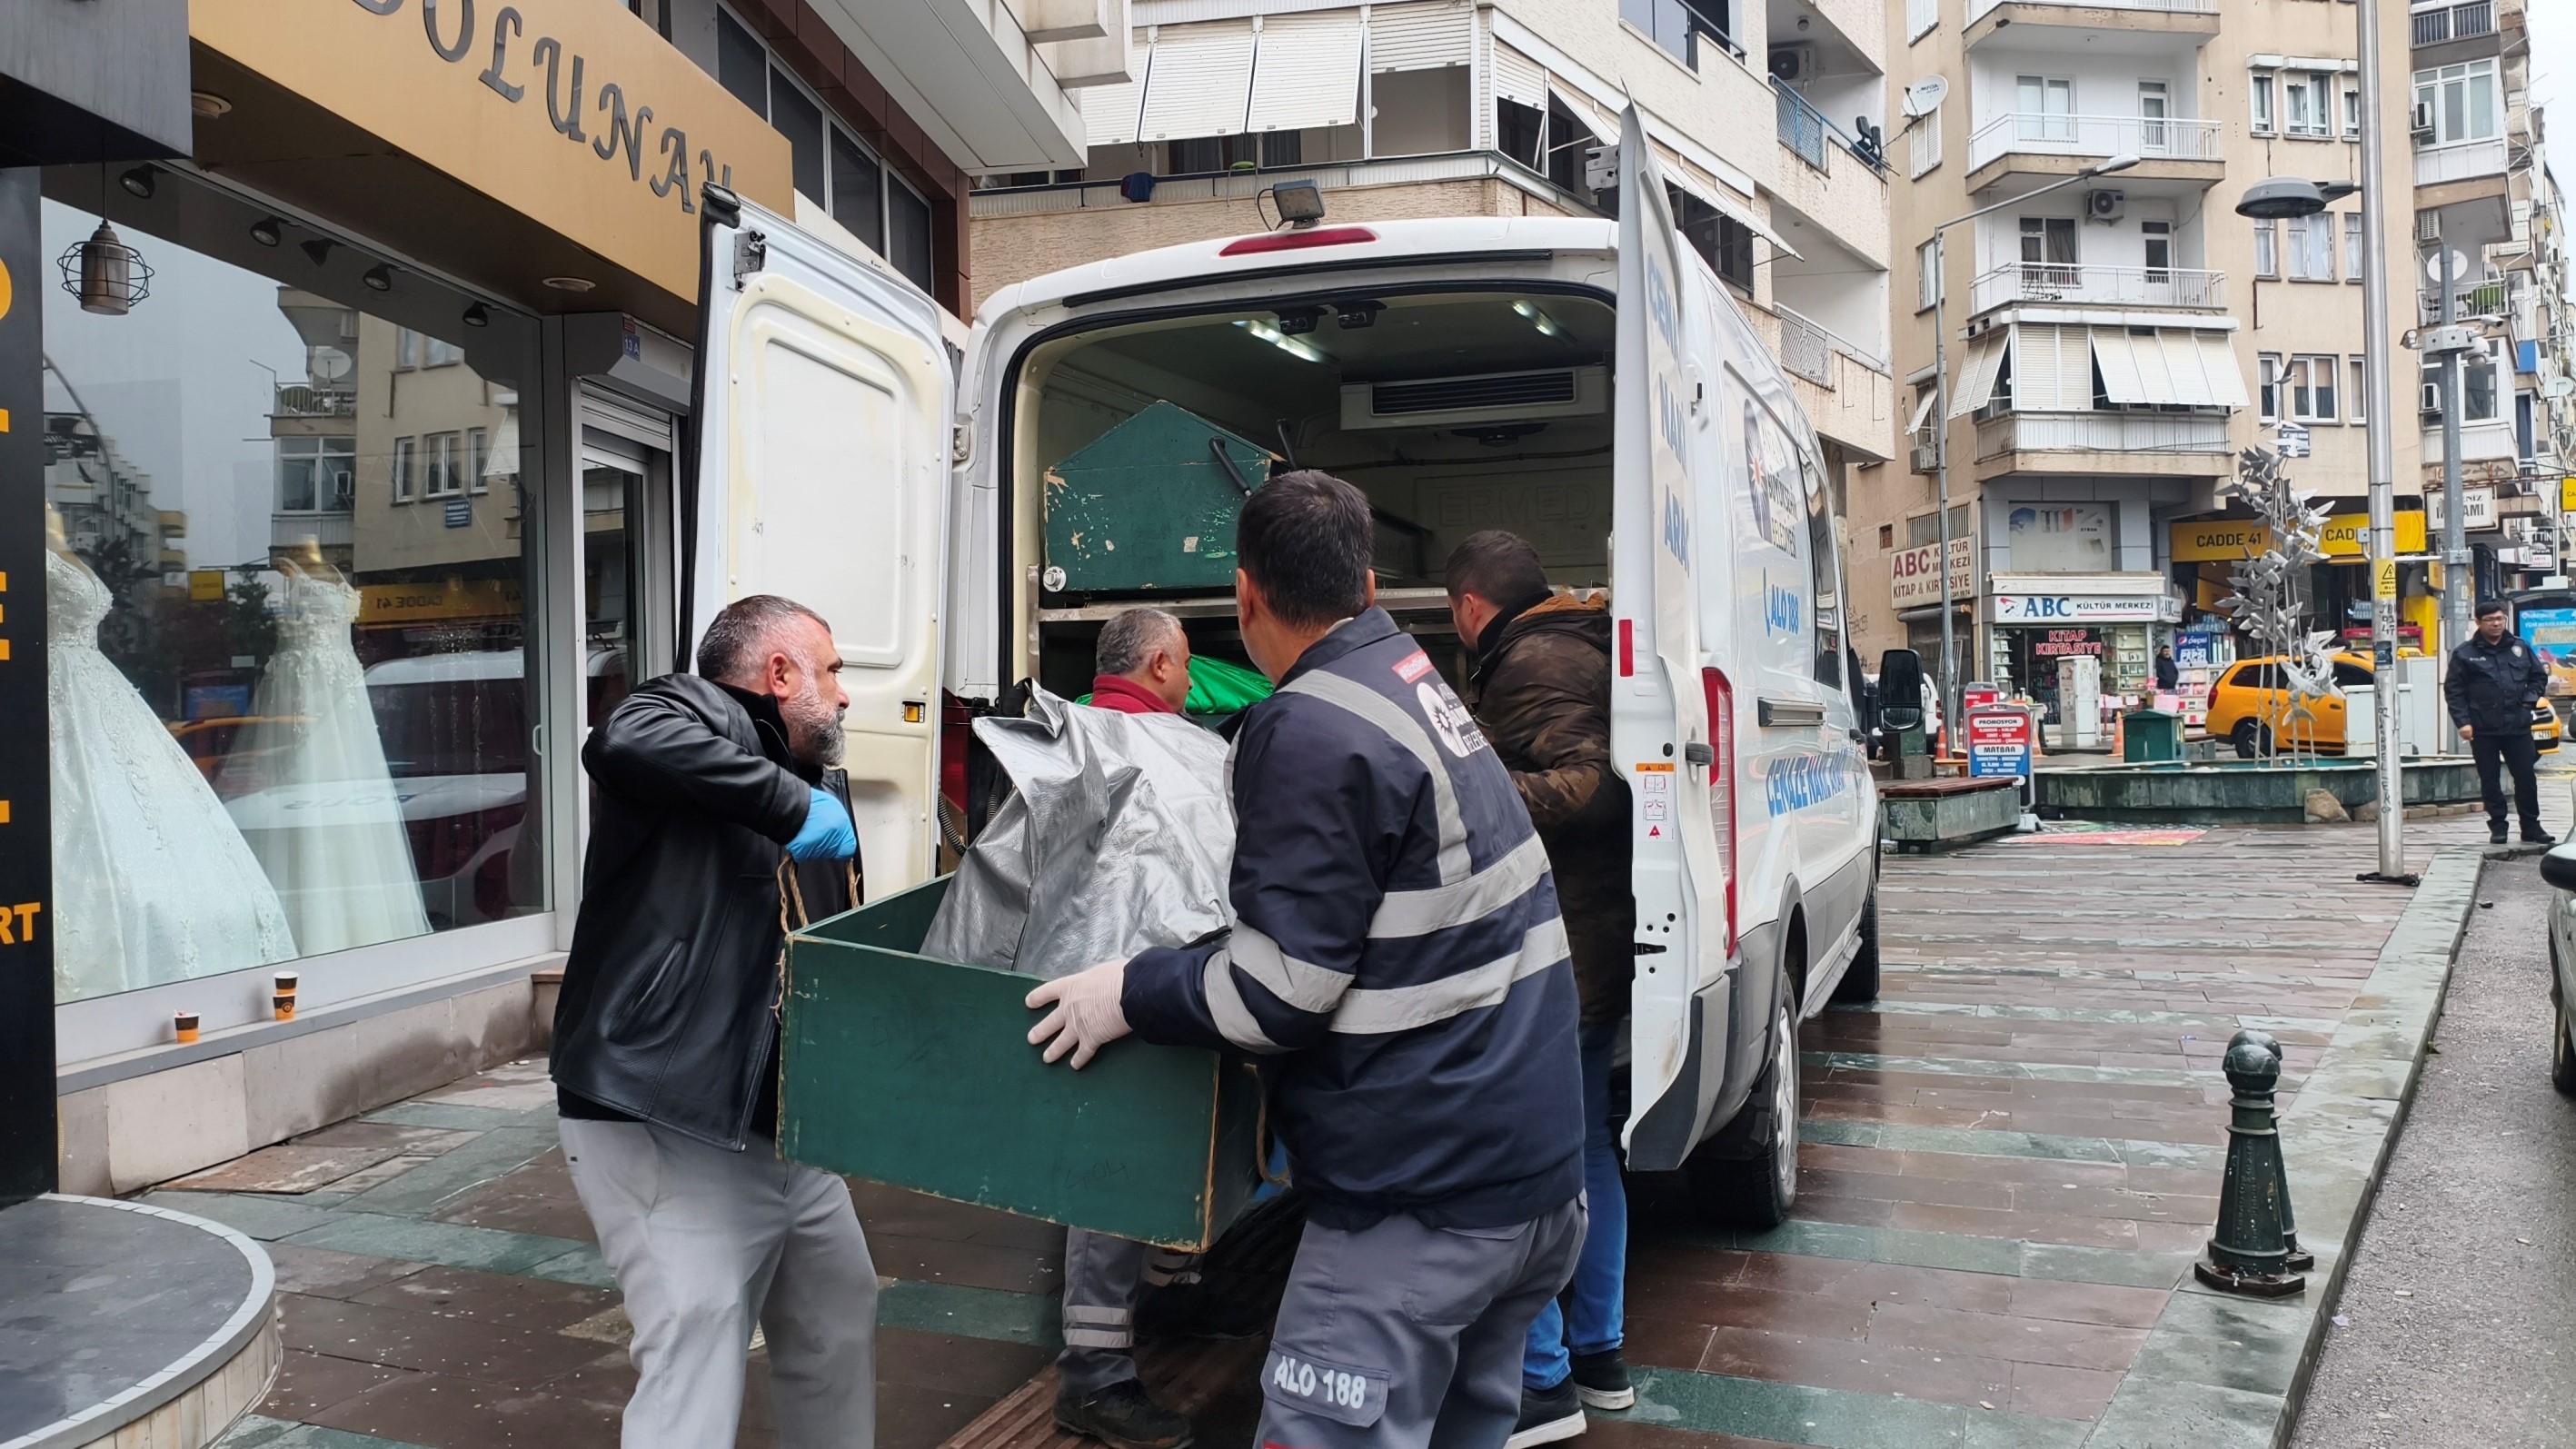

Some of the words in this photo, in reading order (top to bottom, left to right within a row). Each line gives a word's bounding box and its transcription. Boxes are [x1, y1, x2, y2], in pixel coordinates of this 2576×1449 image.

[2196, 532, 2245, 548] CADDE
[2248, 532, 2262, 545] 41
[2325, 528, 2358, 541] CAD
[1893, 548, 1931, 580] ABC
[1934, 540, 1969, 559] KTÜR
[1932, 553, 1971, 574] MKEZİ
[1893, 582, 1916, 600] KİTAP
[1918, 582, 1925, 595] &
[1925, 572, 1970, 595] KIRSİYE
[1771, 584, 1787, 630] ALO
[1788, 591, 1799, 635] 188
[2024, 597, 2072, 618] ABC
[2076, 600, 2113, 610] KÜLTÜR
[2114, 600, 2153, 610] MERKEZİ
[1765, 756, 1811, 819] CENAZE
[0, 902, 41, 944] RT
[1273, 1355, 1317, 1397] ALO
[1323, 1369, 1367, 1409] 188
